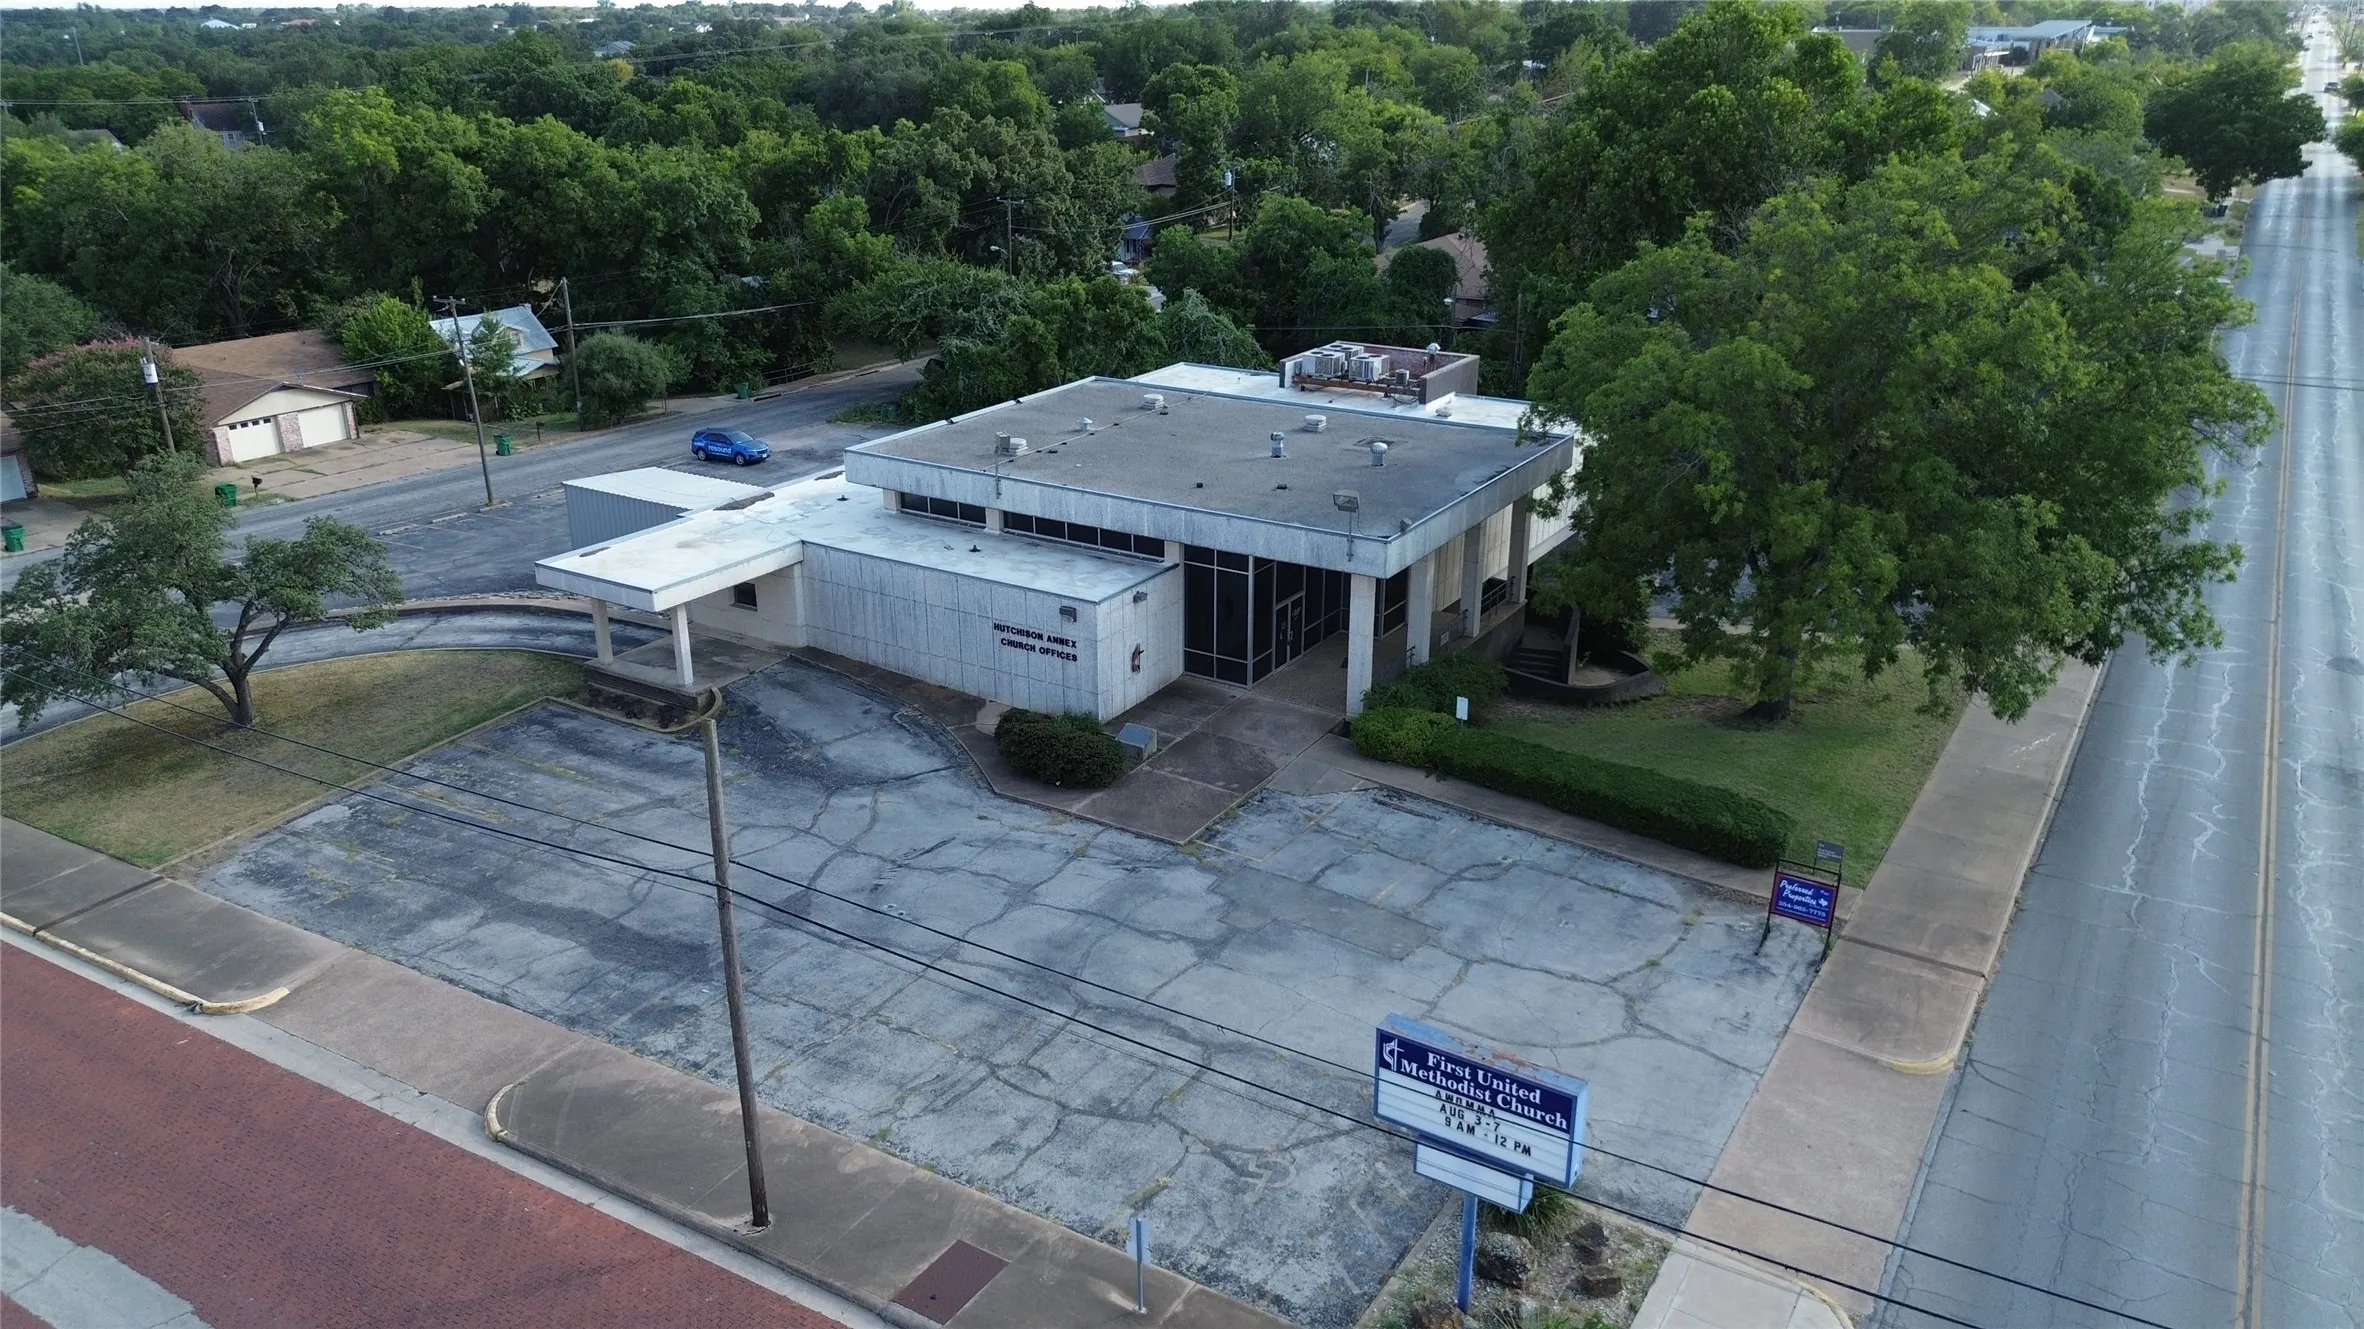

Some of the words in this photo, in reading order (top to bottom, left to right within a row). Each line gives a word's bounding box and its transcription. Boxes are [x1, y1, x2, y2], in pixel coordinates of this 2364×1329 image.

[993, 622, 1044, 642] HUTCHISON
[1046, 635, 1077, 649] ANNEX
[1000, 637, 1036, 653] CHURCH
[1038, 646, 1078, 662] OFFICES
[1779, 879, 1814, 896] Preferred
[1782, 889, 1817, 905] Properties
[1426, 1051, 1472, 1080] First
[1476, 1069, 1542, 1105] United
[1400, 1058, 1492, 1103] Methodist
[1496, 1094, 1568, 1130] Church
[1439, 1103, 1465, 1120] AUG
[1444, 1116, 1452, 1127] 9
[1456, 1121, 1476, 1136] AM
[1494, 1134, 1507, 1148] 12
[1513, 1141, 1532, 1157] PM
